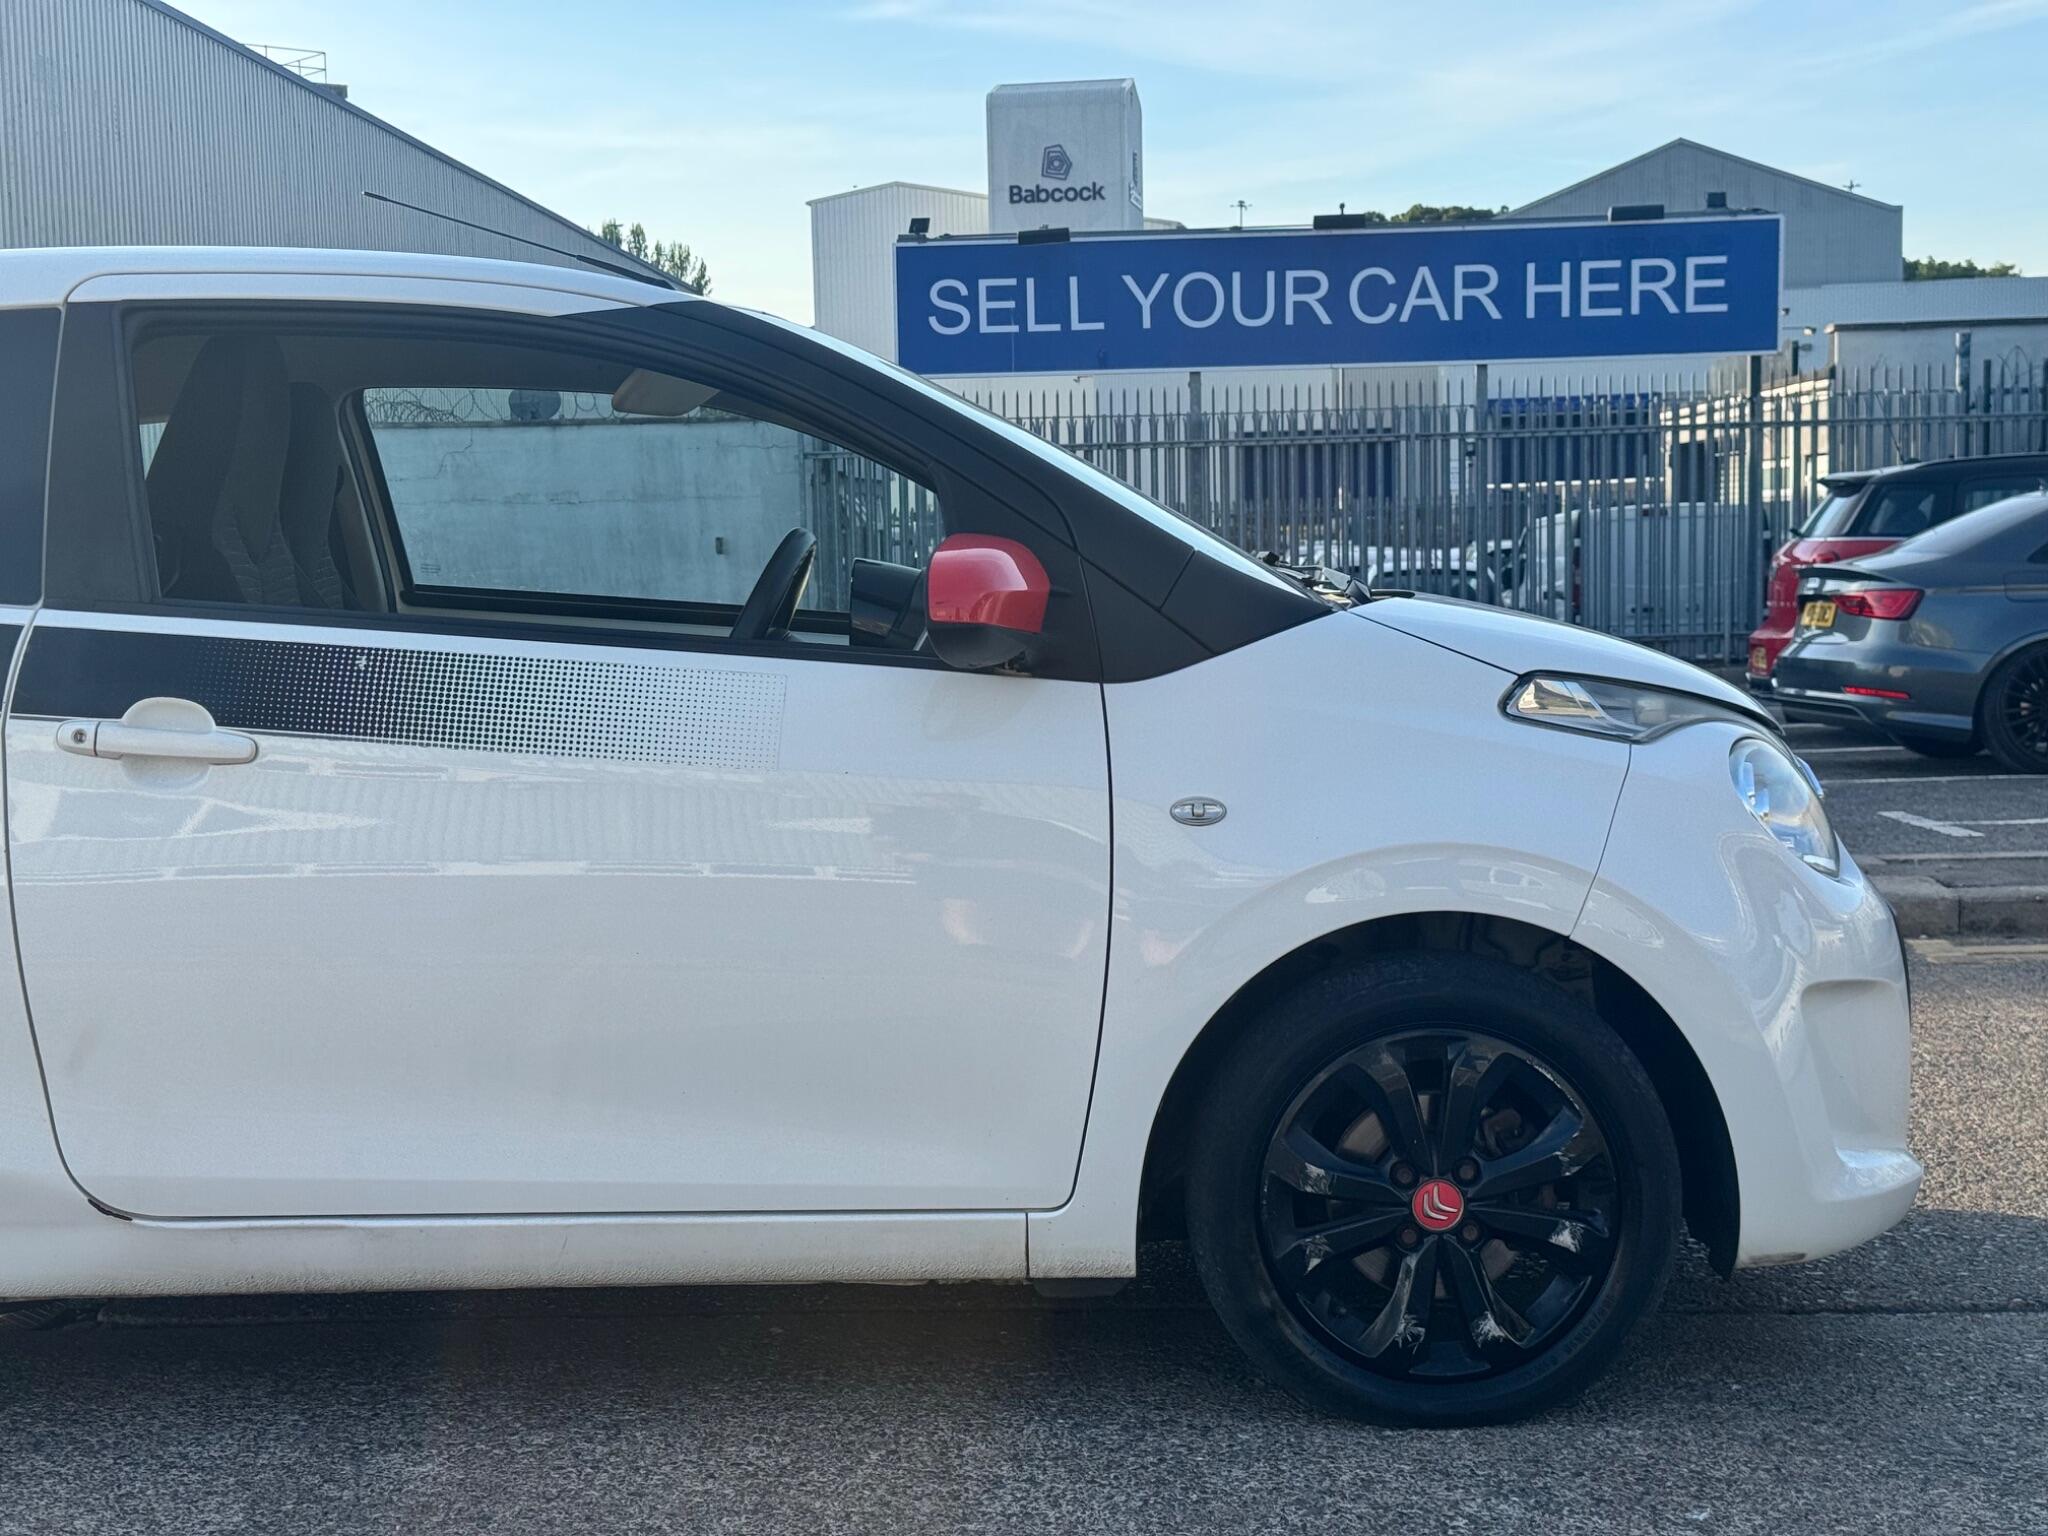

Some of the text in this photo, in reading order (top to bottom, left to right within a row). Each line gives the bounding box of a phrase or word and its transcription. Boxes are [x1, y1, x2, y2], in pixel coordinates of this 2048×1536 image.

[1009, 181, 1105, 204] Babcock
[928, 256, 1728, 335] SELL YOUR CAR HERE
